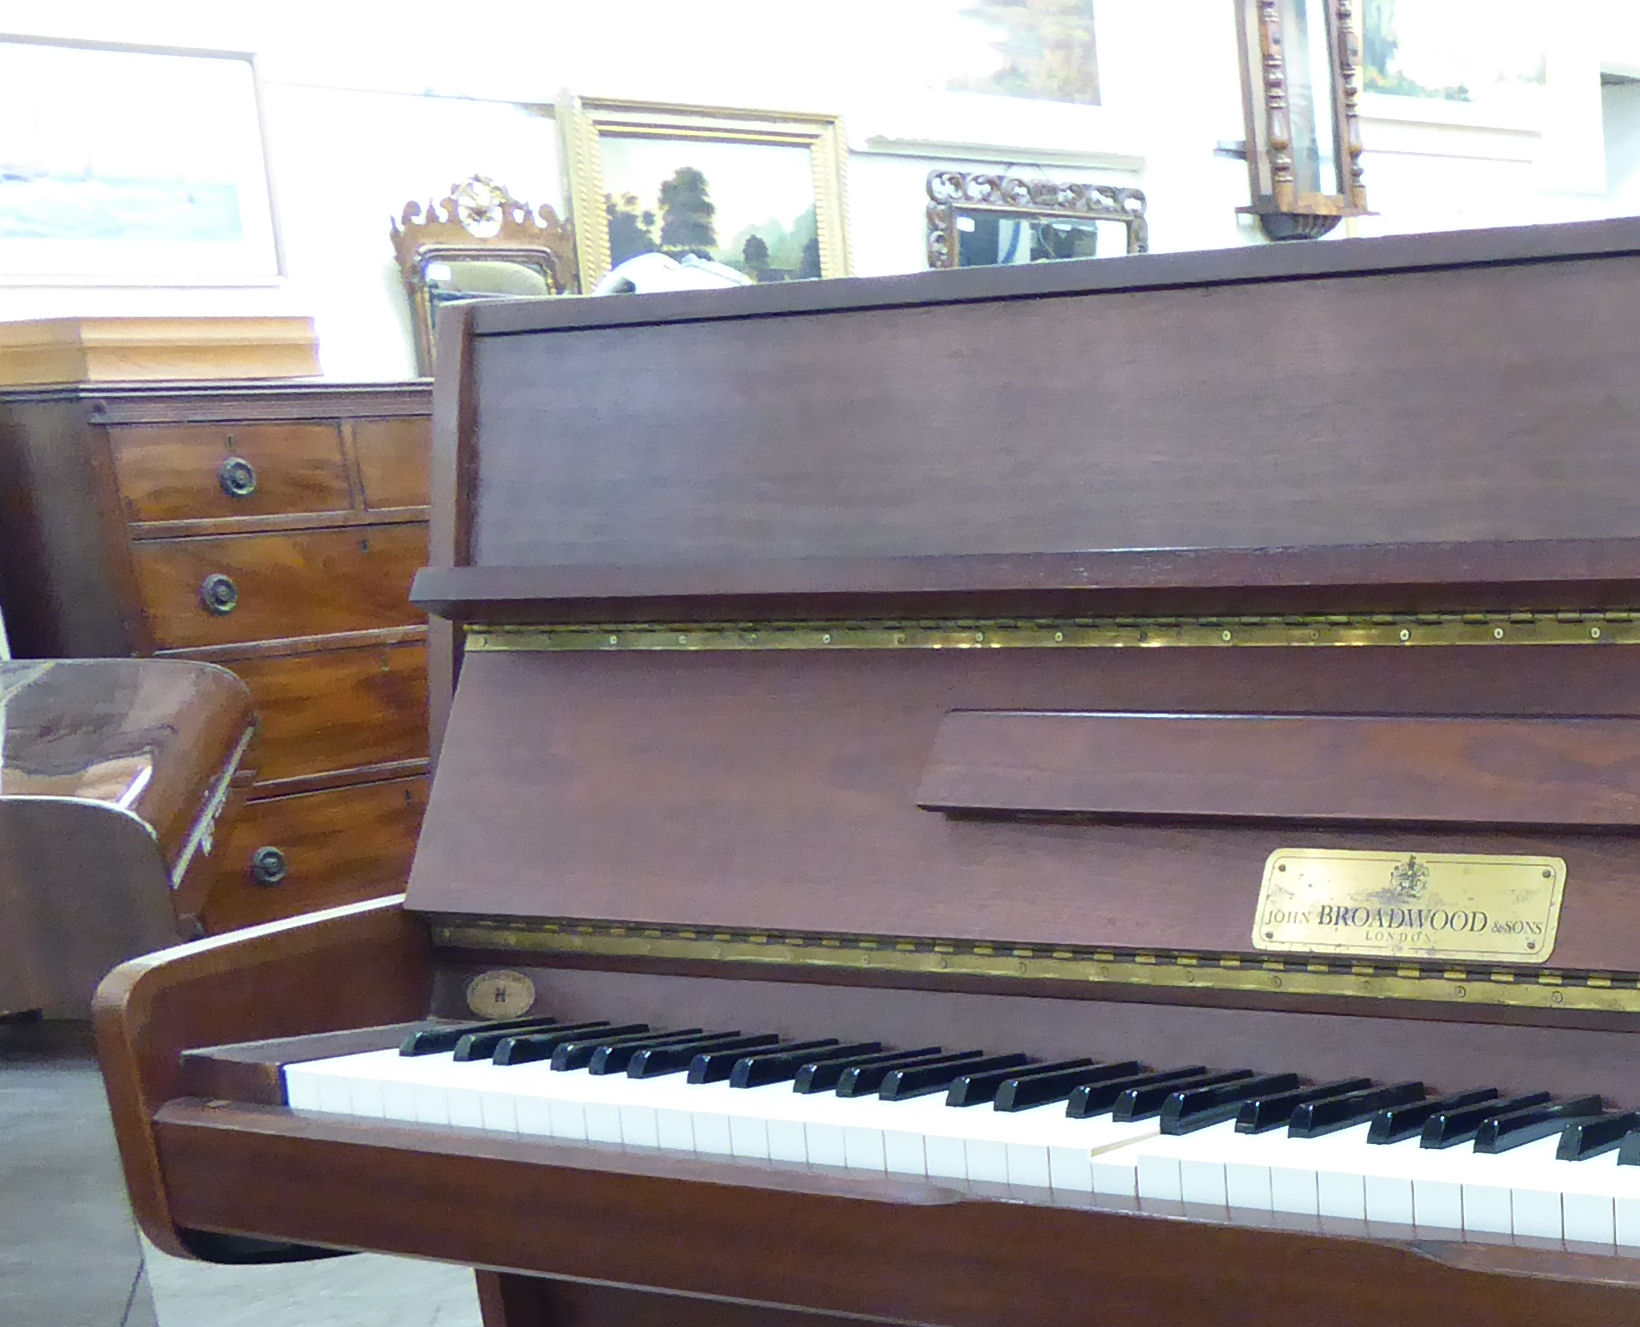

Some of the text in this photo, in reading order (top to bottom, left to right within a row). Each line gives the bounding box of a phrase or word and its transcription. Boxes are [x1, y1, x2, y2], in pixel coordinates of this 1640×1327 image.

[1264, 908, 1312, 925] JOHN
[1317, 904, 1489, 933] BROADWOOD
[1364, 930, 1433, 943] LONDON
